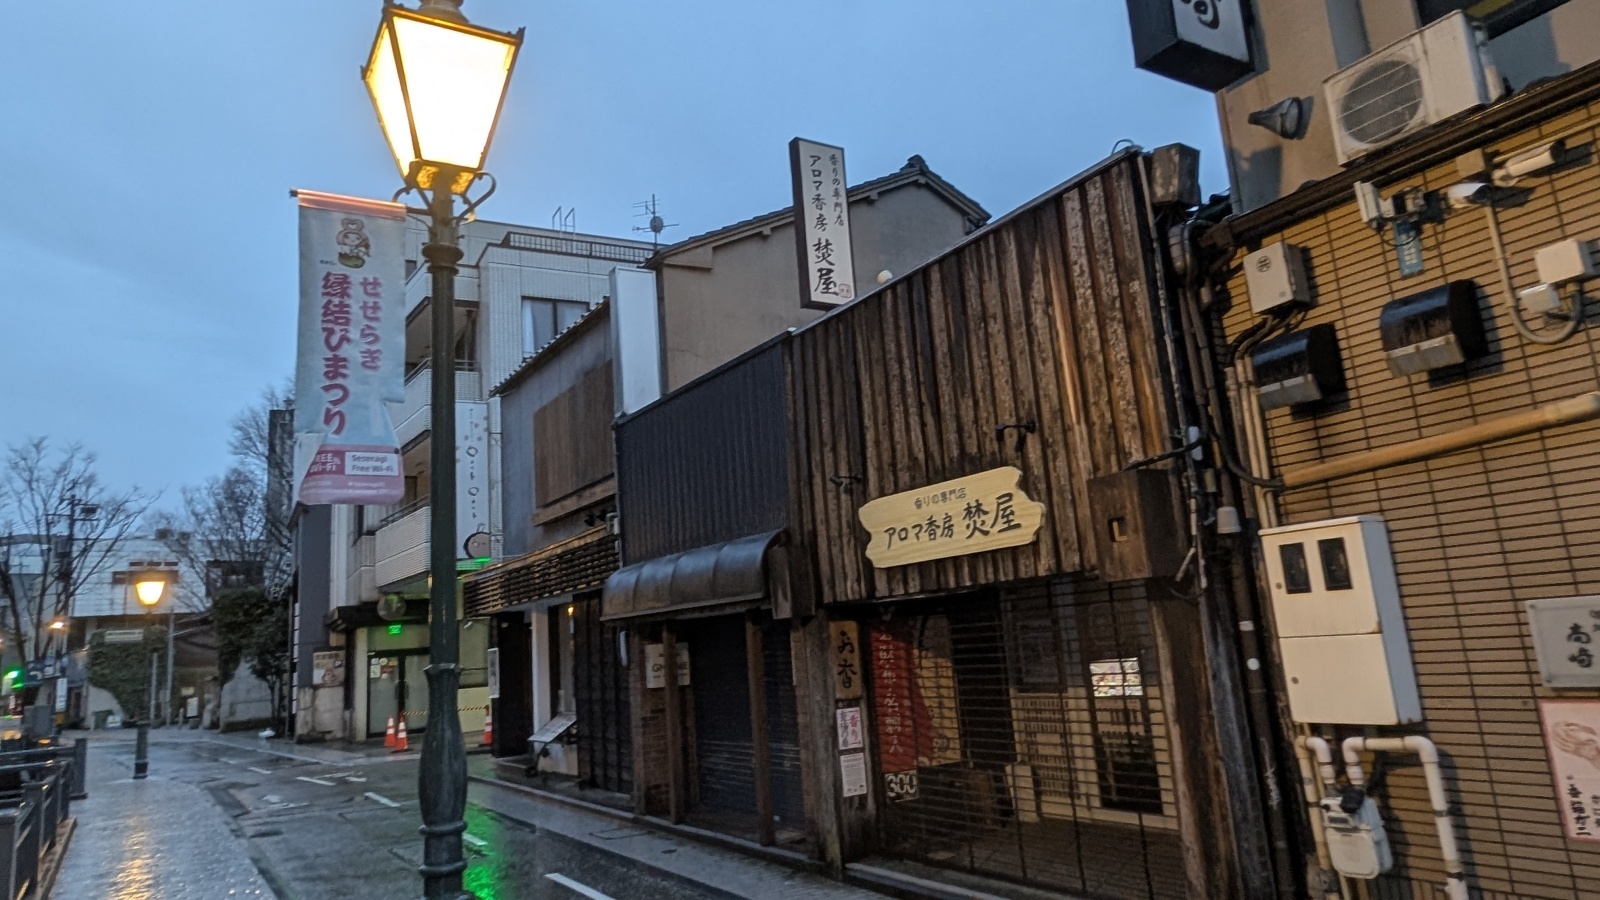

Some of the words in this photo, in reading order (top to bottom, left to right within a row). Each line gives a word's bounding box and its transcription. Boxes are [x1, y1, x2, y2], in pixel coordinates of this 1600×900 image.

[809, 155, 829, 232] アロマ香房
[829, 154, 845, 226] 香りの専門店
[812, 237, 839, 296] 焚屋
[320, 270, 353, 436] 縁結びまつり
[358, 276, 383, 372] せせらぎ
[352, 454, 388, 464] Seseragi
[352, 464, 370, 473] Free
[371, 464, 393, 473] Wi-Fi
[884, 512, 954, 550] アロマ香房
[962, 492, 1022, 539] 焚屋
[914, 487, 967, 510] 香りの専門店
